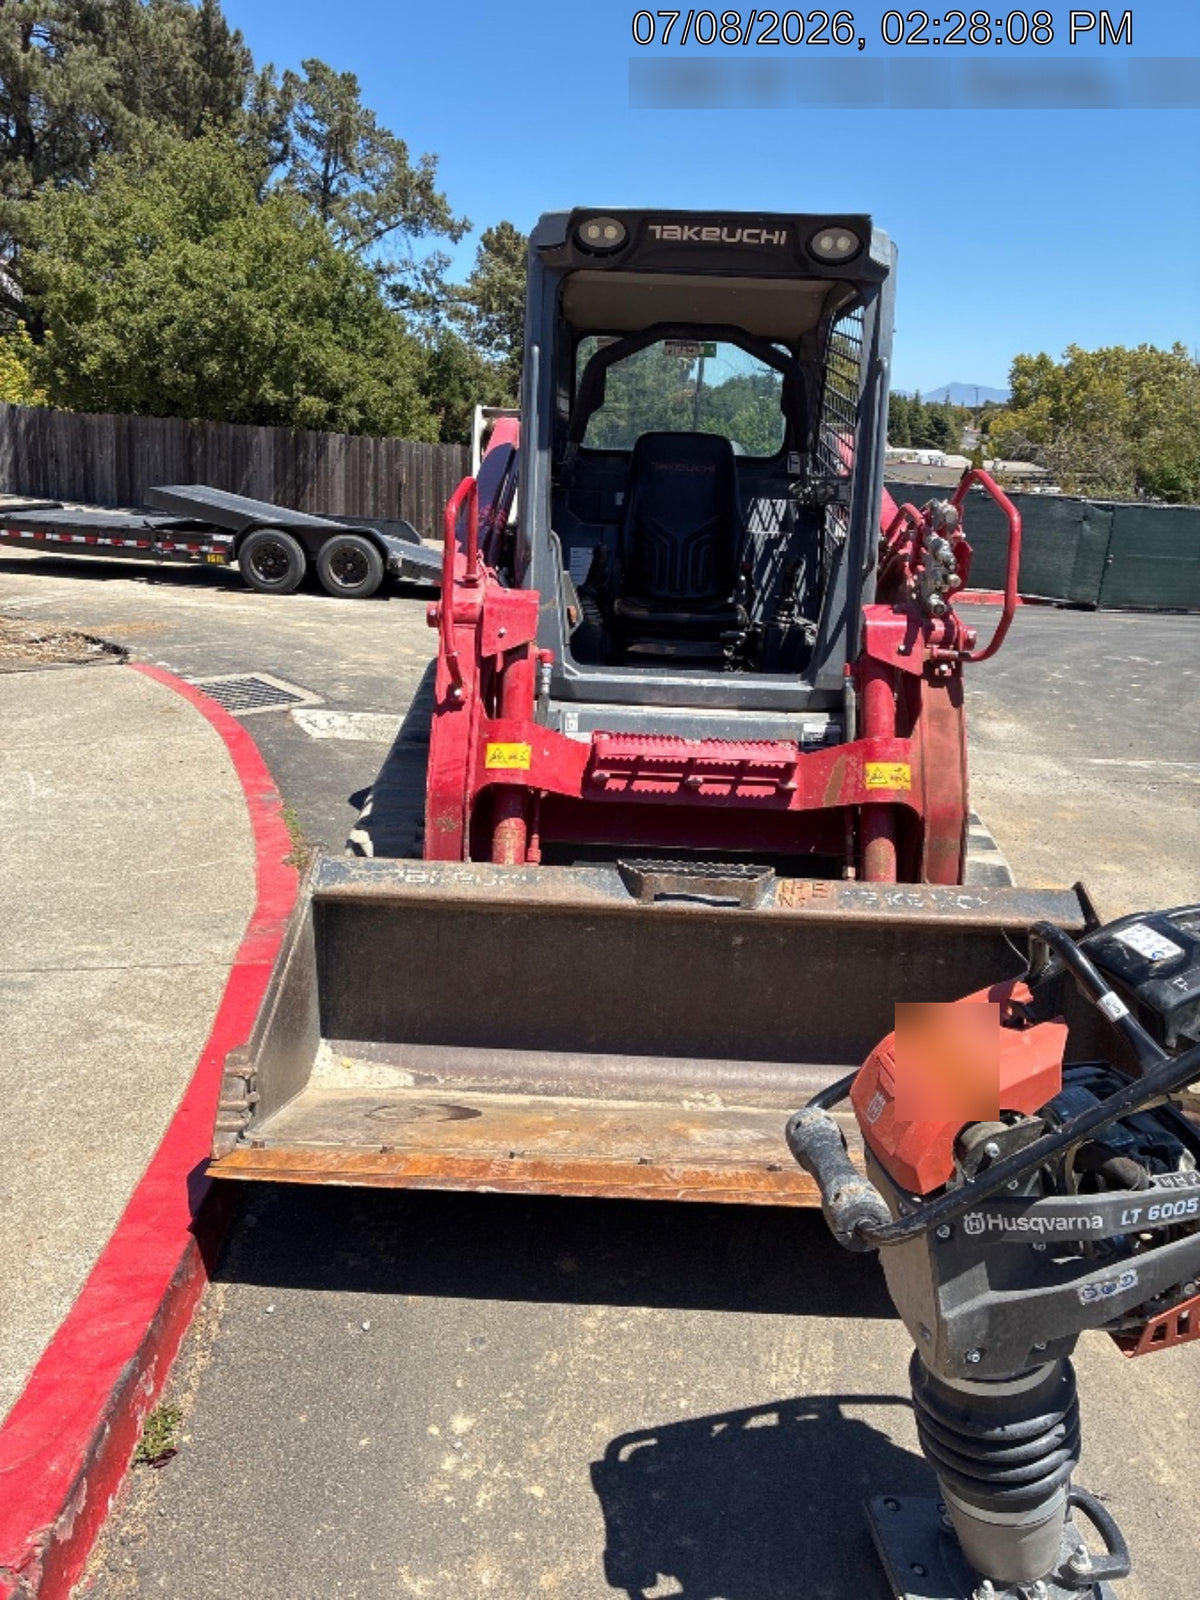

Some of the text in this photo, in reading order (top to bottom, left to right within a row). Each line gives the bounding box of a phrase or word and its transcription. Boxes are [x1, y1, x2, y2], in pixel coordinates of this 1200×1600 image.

[1120, 1197, 1199, 1225] LT 6005
[986, 1213, 1104, 1235] Husqvarna
